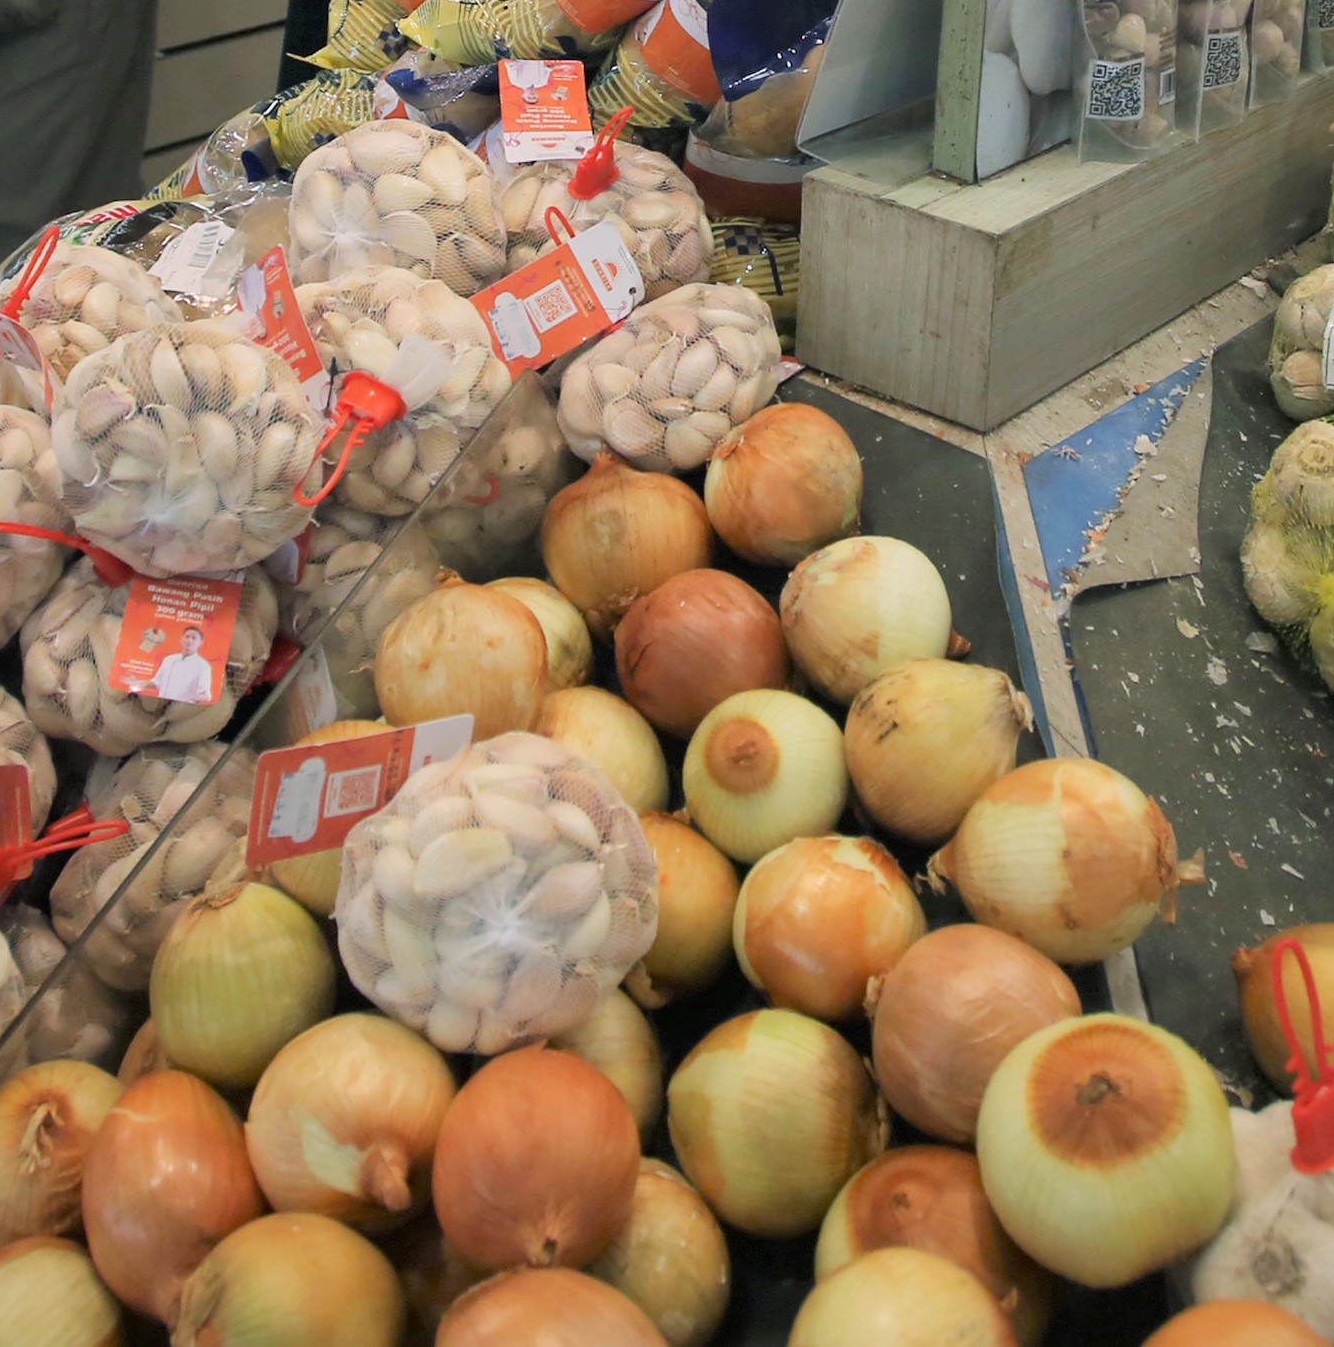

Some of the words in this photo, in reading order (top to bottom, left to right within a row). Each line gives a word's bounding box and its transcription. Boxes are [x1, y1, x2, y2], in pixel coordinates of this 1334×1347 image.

[147, 584, 190, 599] Bawang
[193, 591, 223, 603] Putih
[190, 600, 215, 612] Pipil
[177, 609, 204, 620] gram
